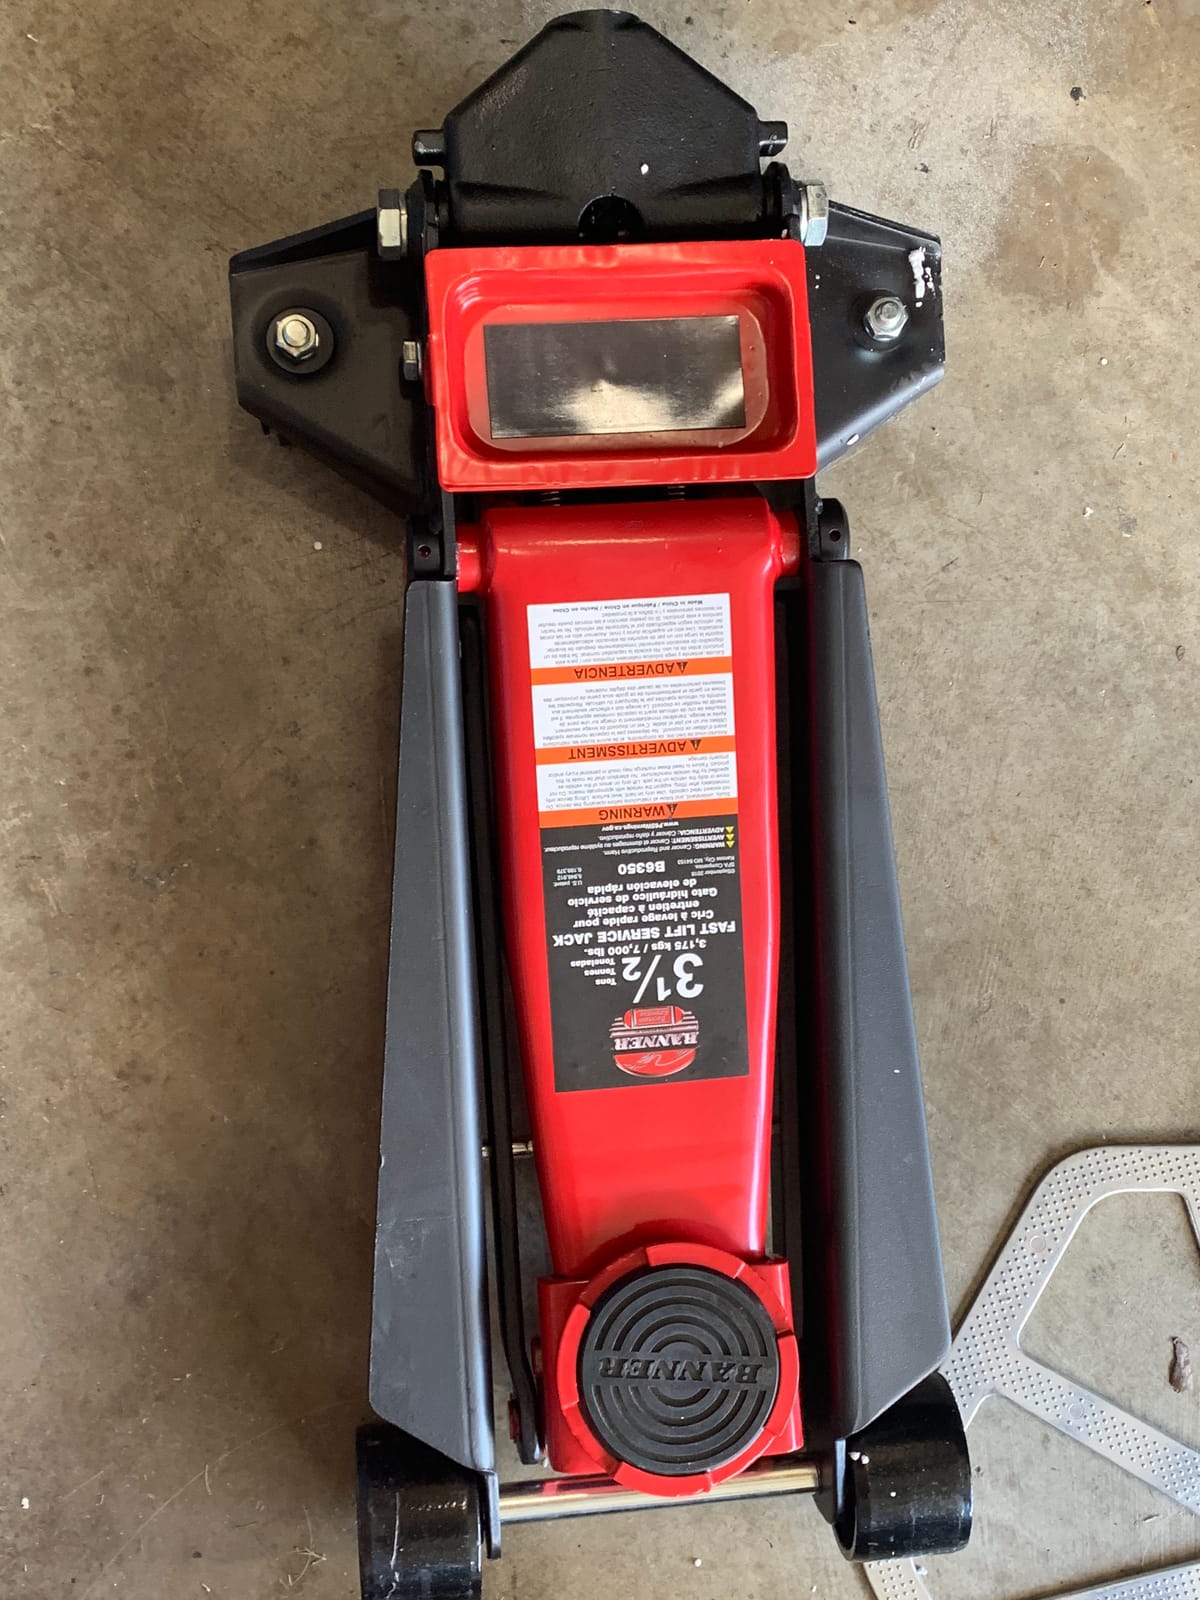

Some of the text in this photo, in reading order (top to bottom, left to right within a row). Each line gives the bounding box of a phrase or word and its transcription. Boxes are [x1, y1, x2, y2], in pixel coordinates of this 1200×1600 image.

[573, 662, 674, 679] ADVERTENCIA
[567, 740, 686, 759] ADVERTISSMENT
[598, 805, 665, 820] WARNING
[617, 859, 665, 875] B6350
[586, 877, 697, 895] de elevación rápida
[566, 886, 718, 908] Gato hidráulico de servicio
[586, 899, 700, 918] entretien à capacité
[572, 908, 714, 928] Cric à levage rapide pour
[551, 920, 736, 947] FAST LIFT SERVICE JACK
[583, 946, 605, 957] lbs.
[607, 943, 640, 956] 7,000
[650, 940, 671, 951] kgs
[673, 937, 707, 950] 3,175
[569, 957, 616, 968] Toneladas
[583, 967, 616, 976] Tonnes
[594, 977, 617, 985] Tons
[613, 1030, 699, 1050] BANNER
[599, 1357, 762, 1384] BANNER
